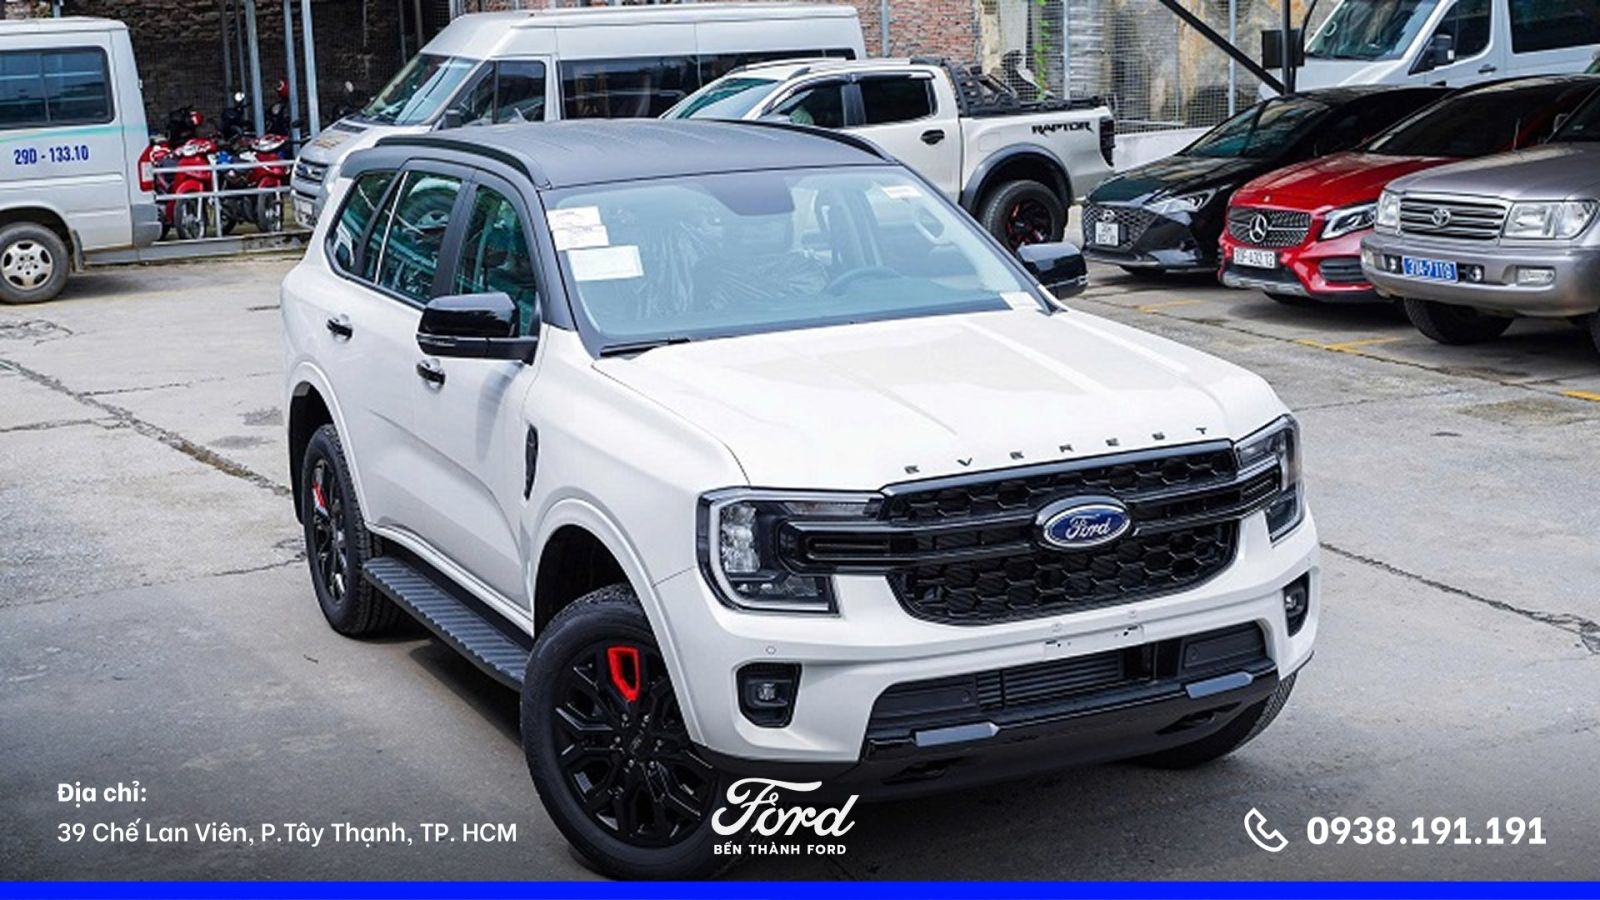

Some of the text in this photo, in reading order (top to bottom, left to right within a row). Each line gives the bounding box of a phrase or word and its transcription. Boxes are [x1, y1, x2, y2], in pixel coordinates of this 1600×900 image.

[1032, 121, 1094, 137] RAPTOR
[49, 145, 89, 162] 133.10
[904, 427, 1206, 474] EVEREST
[1065, 514, 1111, 540] Ford
